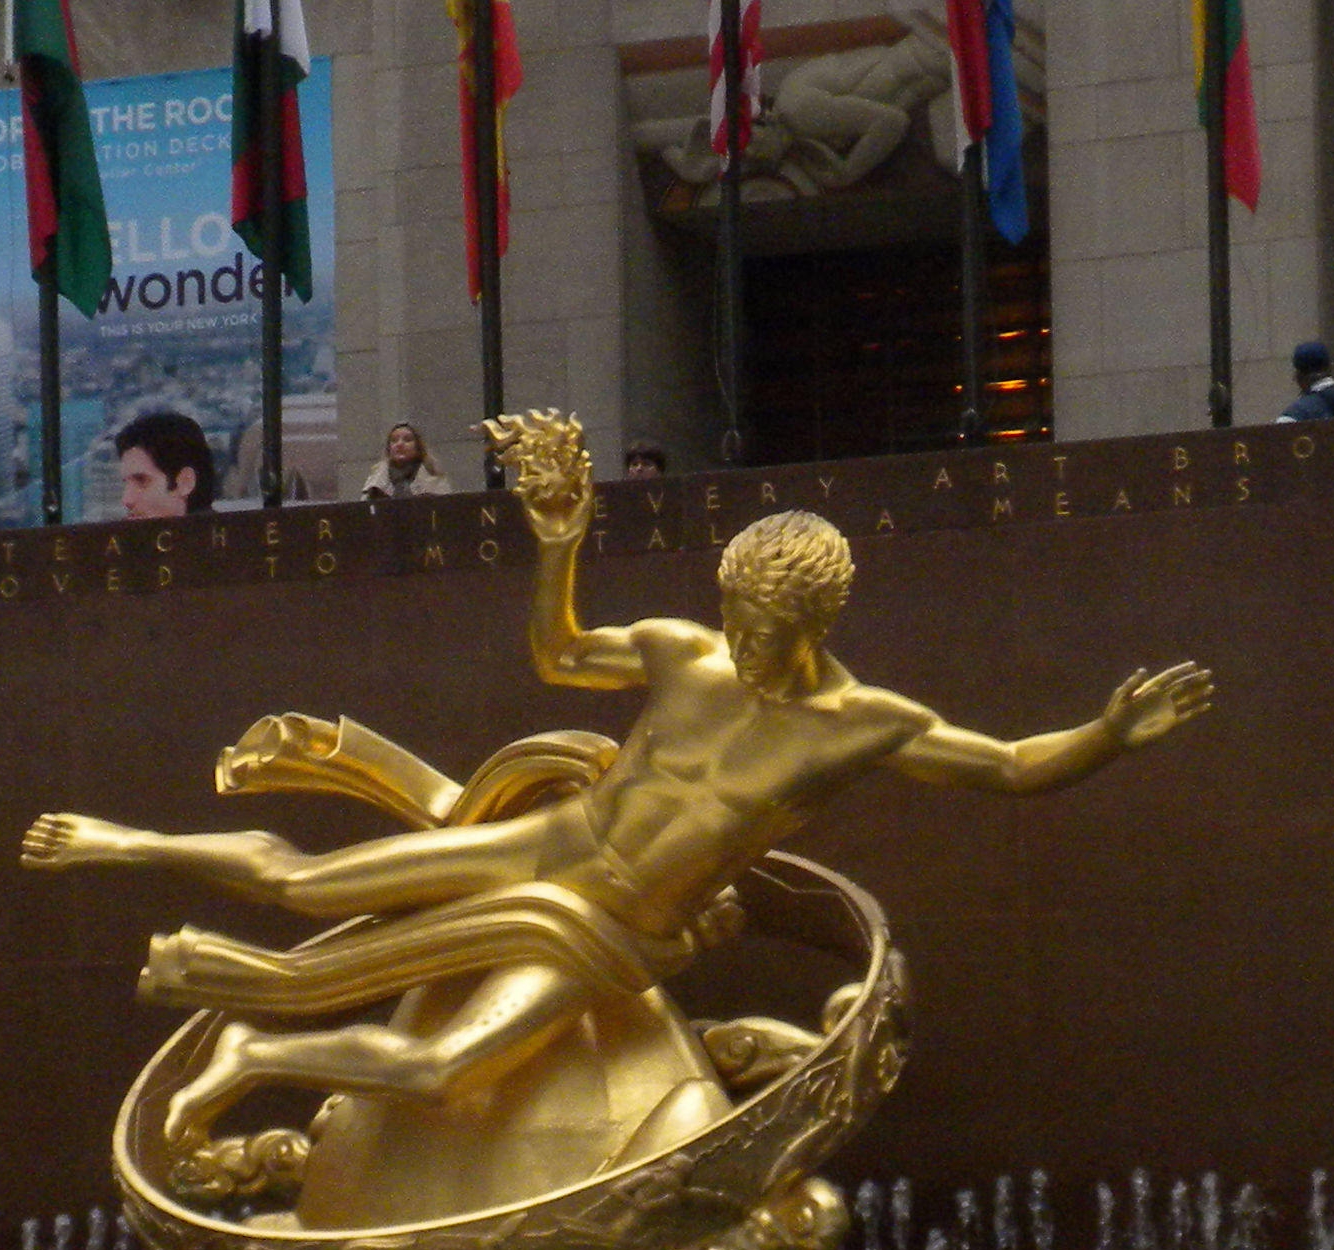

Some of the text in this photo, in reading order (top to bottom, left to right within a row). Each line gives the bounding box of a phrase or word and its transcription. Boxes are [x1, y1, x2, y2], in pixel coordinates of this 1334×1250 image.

[92, 101, 156, 134] THE
[165, 94, 233, 127] ROC
[170, 130, 232, 156] DECK
[107, 211, 230, 265] ELLO
[100, 312, 258, 338] THIS IS YOUR NEW YORK
[1, 518, 334, 561] TEACHER
[430, 505, 497, 531] IN
[593, 476, 835, 519] EVERY
[933, 455, 1068, 490] ART
[265, 551, 337, 578] TO
[875, 508, 896, 532] A
[993, 476, 1251, 521] MEANS
